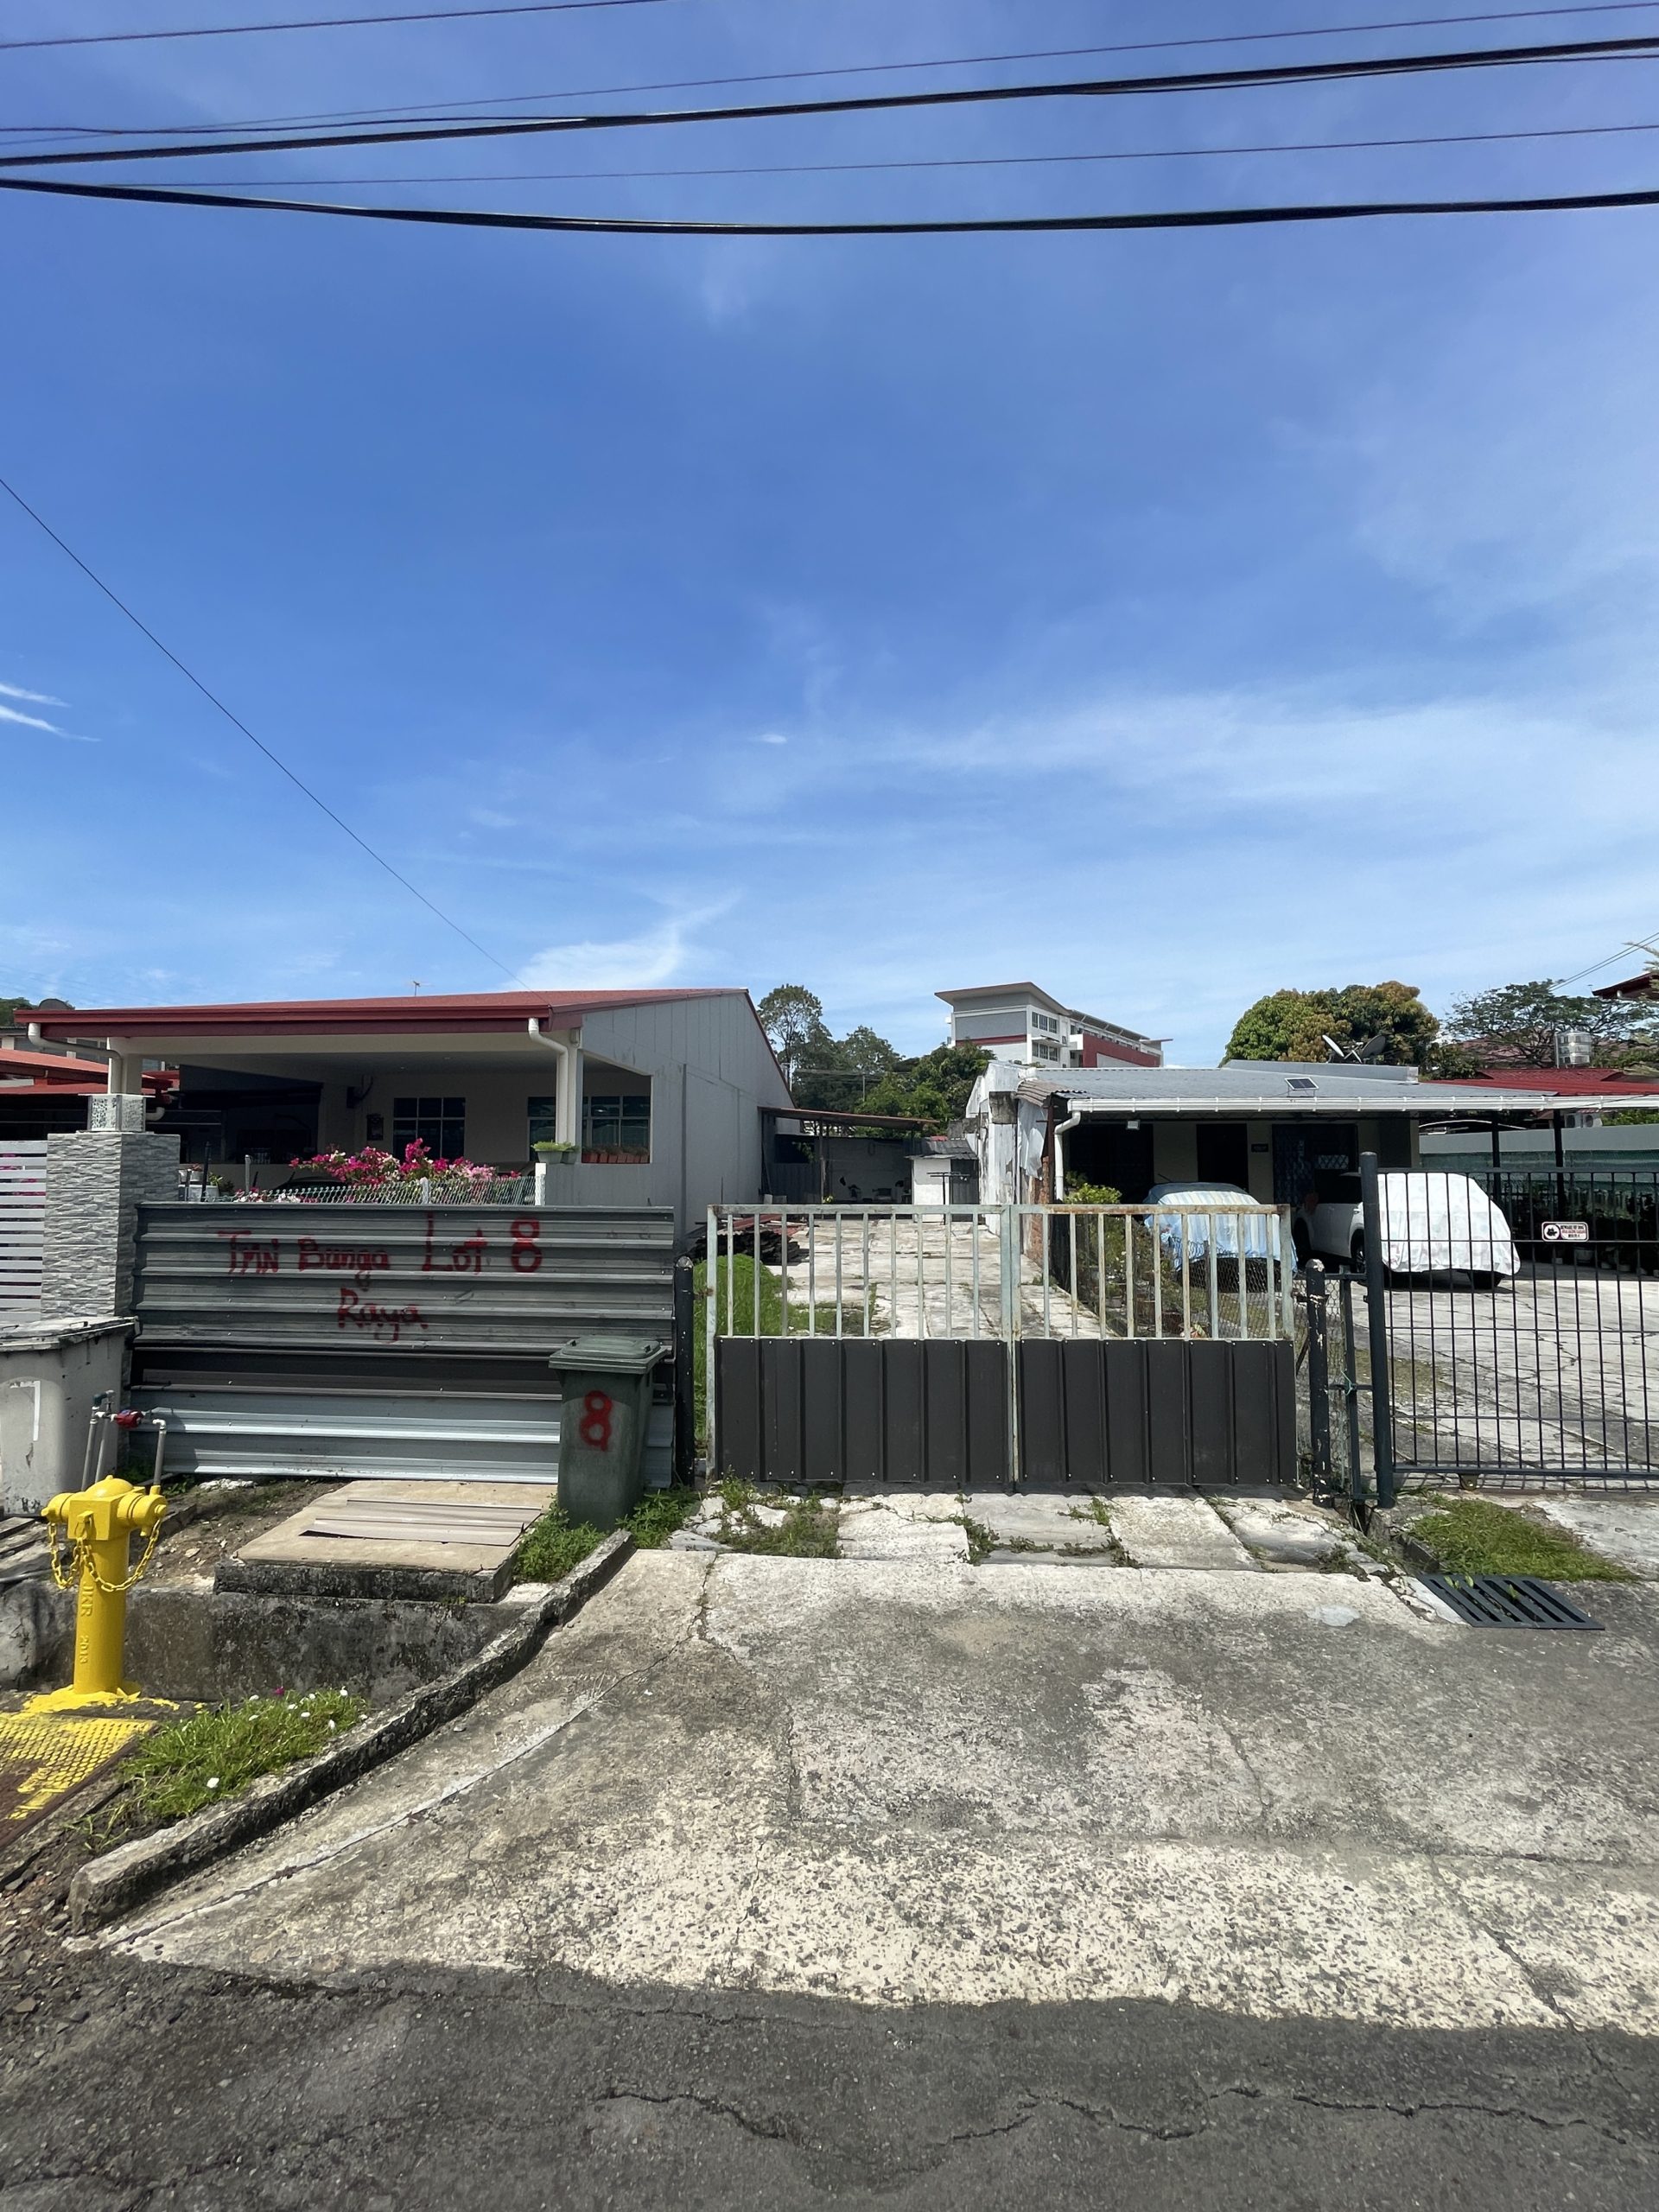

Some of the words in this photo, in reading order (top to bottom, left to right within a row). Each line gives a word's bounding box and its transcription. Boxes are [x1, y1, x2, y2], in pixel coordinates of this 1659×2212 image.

[297, 1237, 390, 1292] Bunga
[510, 1217, 543, 1274] 8
[337, 1287, 429, 1344] Raya
[579, 1389, 613, 1452] 8
[80, 1580, 93, 1617] JKR
